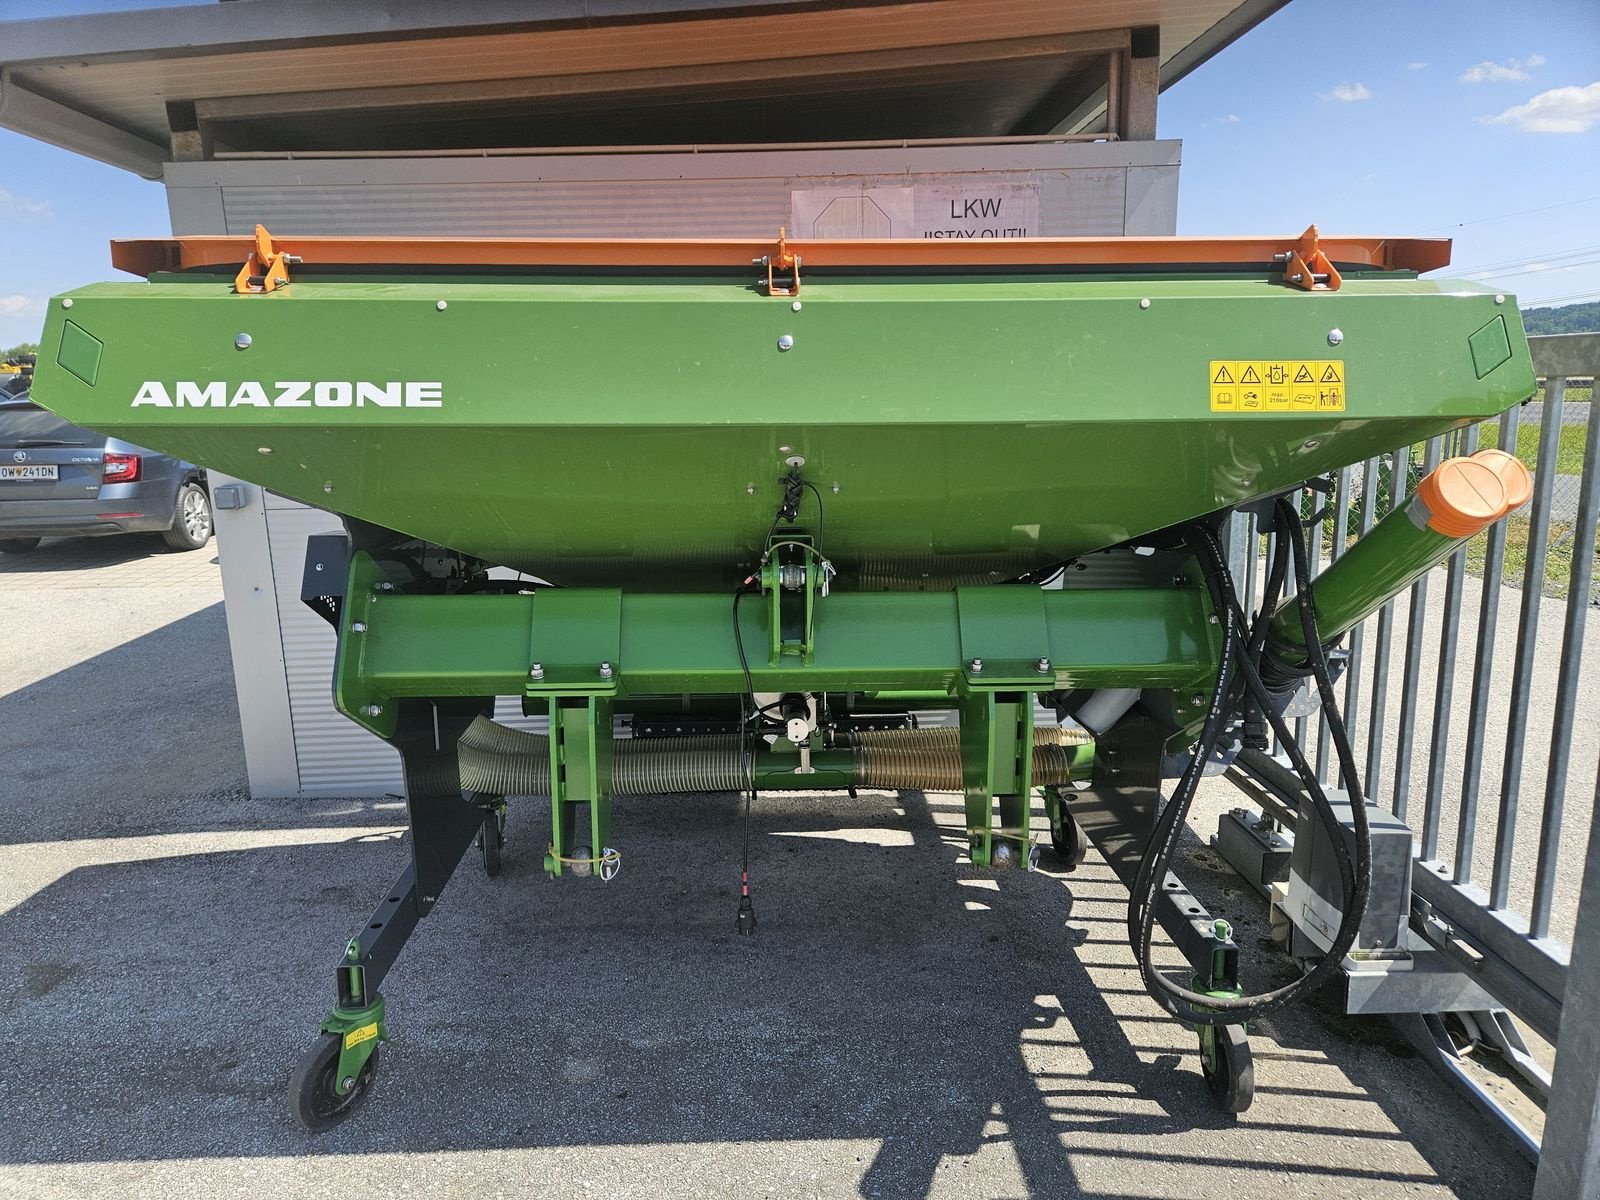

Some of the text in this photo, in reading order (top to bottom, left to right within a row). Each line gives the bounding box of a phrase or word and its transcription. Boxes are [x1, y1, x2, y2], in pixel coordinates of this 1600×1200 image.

[951, 198, 1002, 218] LKW
[131, 381, 443, 407] AMAZONE
[2, 467, 54, 477] OW 241DN
